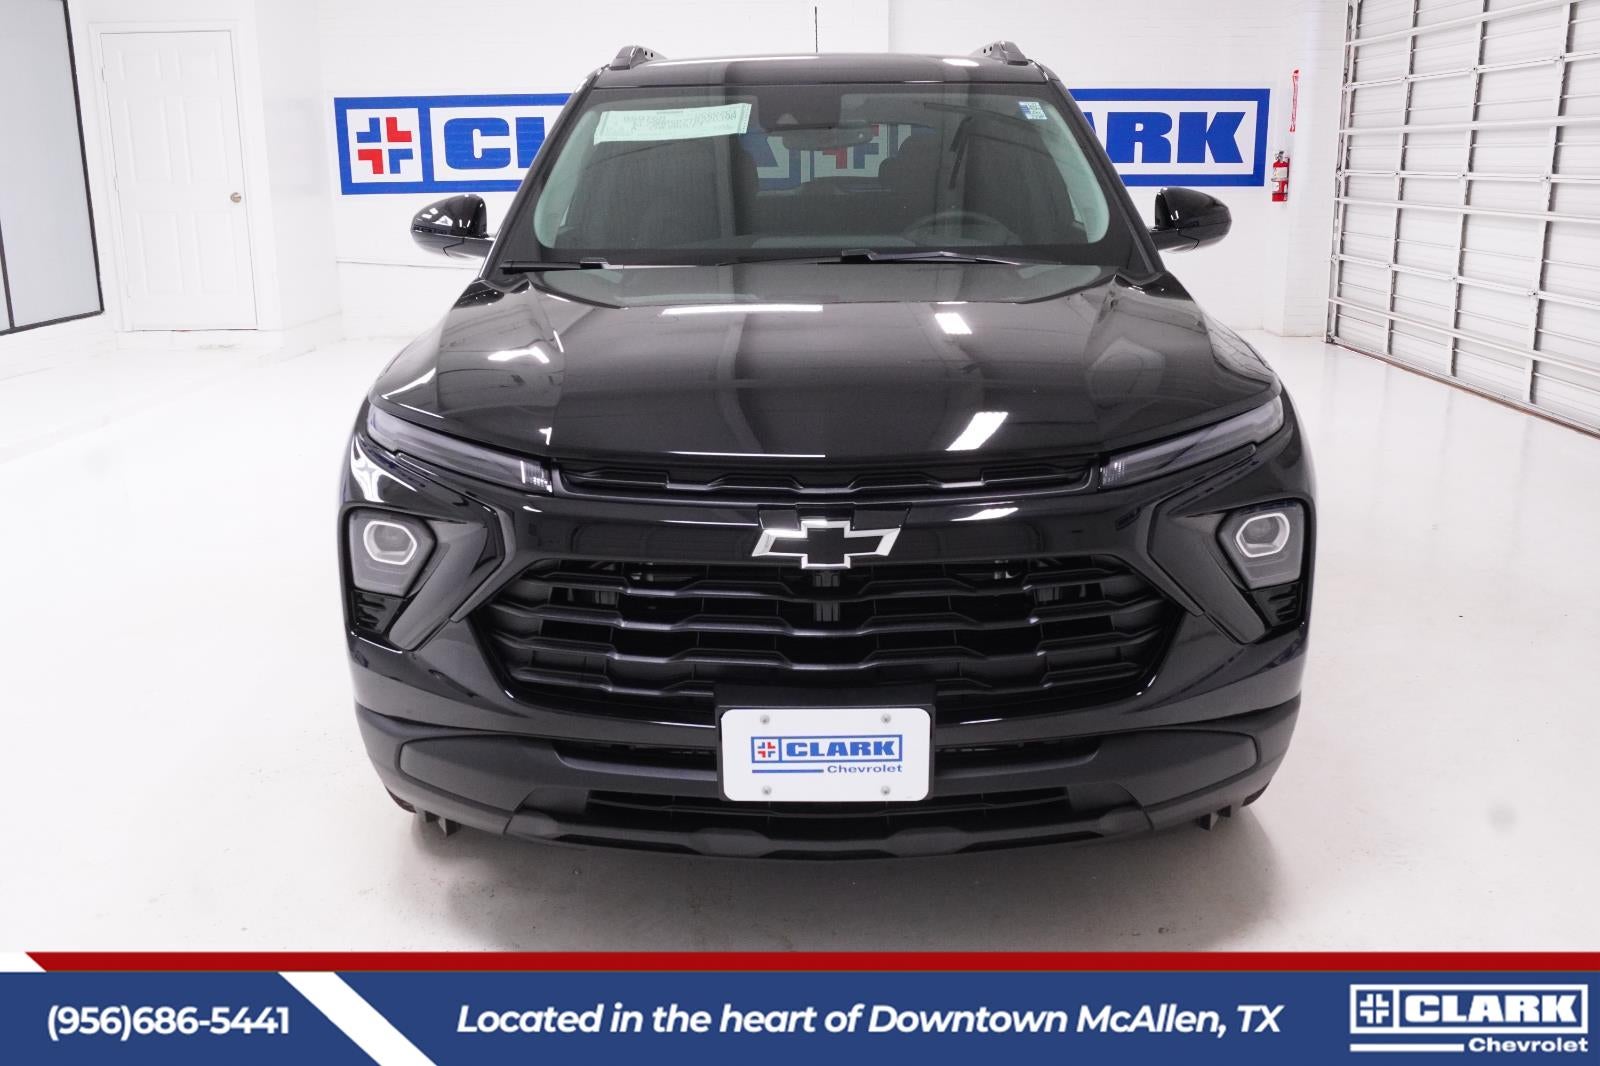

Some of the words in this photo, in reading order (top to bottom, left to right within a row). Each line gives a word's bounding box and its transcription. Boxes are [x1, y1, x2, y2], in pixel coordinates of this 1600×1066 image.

[443, 116, 546, 170] CL
[785, 740, 896, 758] CLARK
[826, 764, 904, 774] Chevrolet
